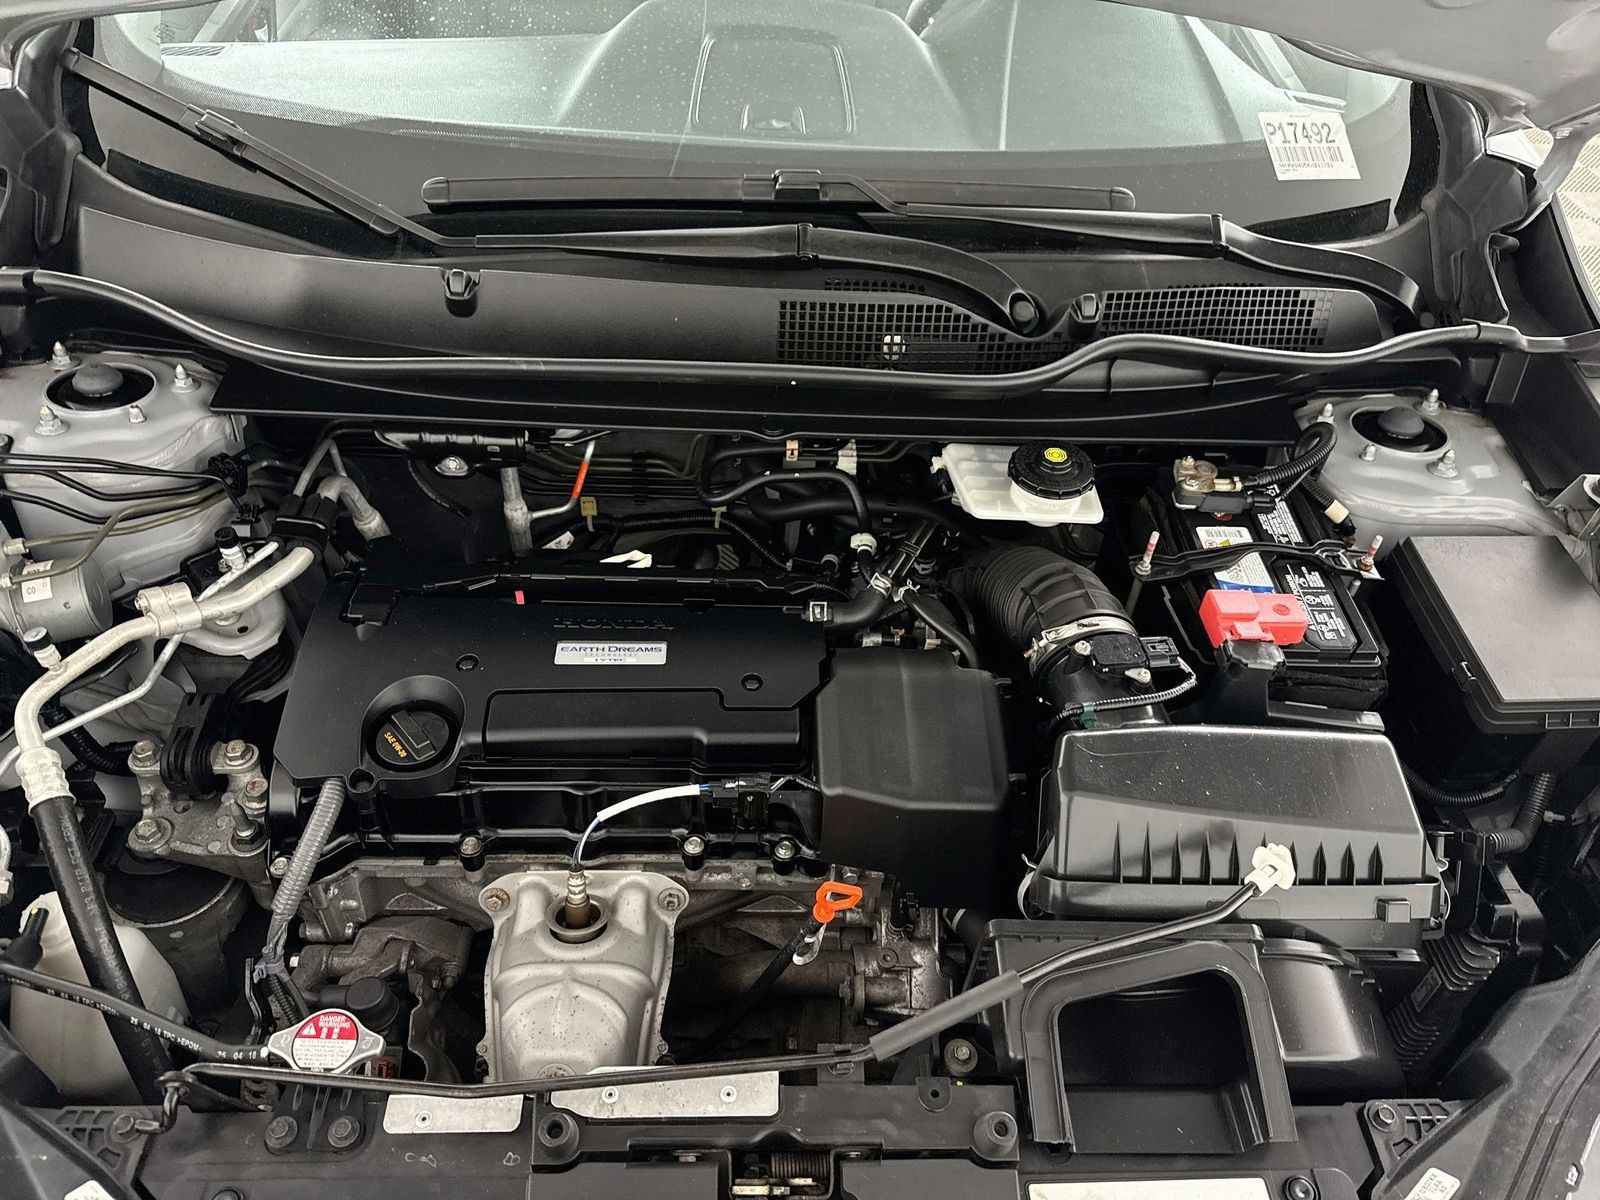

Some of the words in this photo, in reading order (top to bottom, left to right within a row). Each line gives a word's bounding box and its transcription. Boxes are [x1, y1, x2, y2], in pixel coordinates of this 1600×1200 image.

[1264, 122, 1336, 144] P17492
[553, 617, 675, 630] HONDA
[608, 645, 663, 653] DREAMS
[384, 731, 396, 745] SAE
[320, 1014, 346, 1022] DANGER
[318, 1021, 350, 1029] WARNING
[163, 1030, 176, 1042] TPC
[233, 1051, 243, 1060] 04
[248, 1050, 257, 1059] 18
